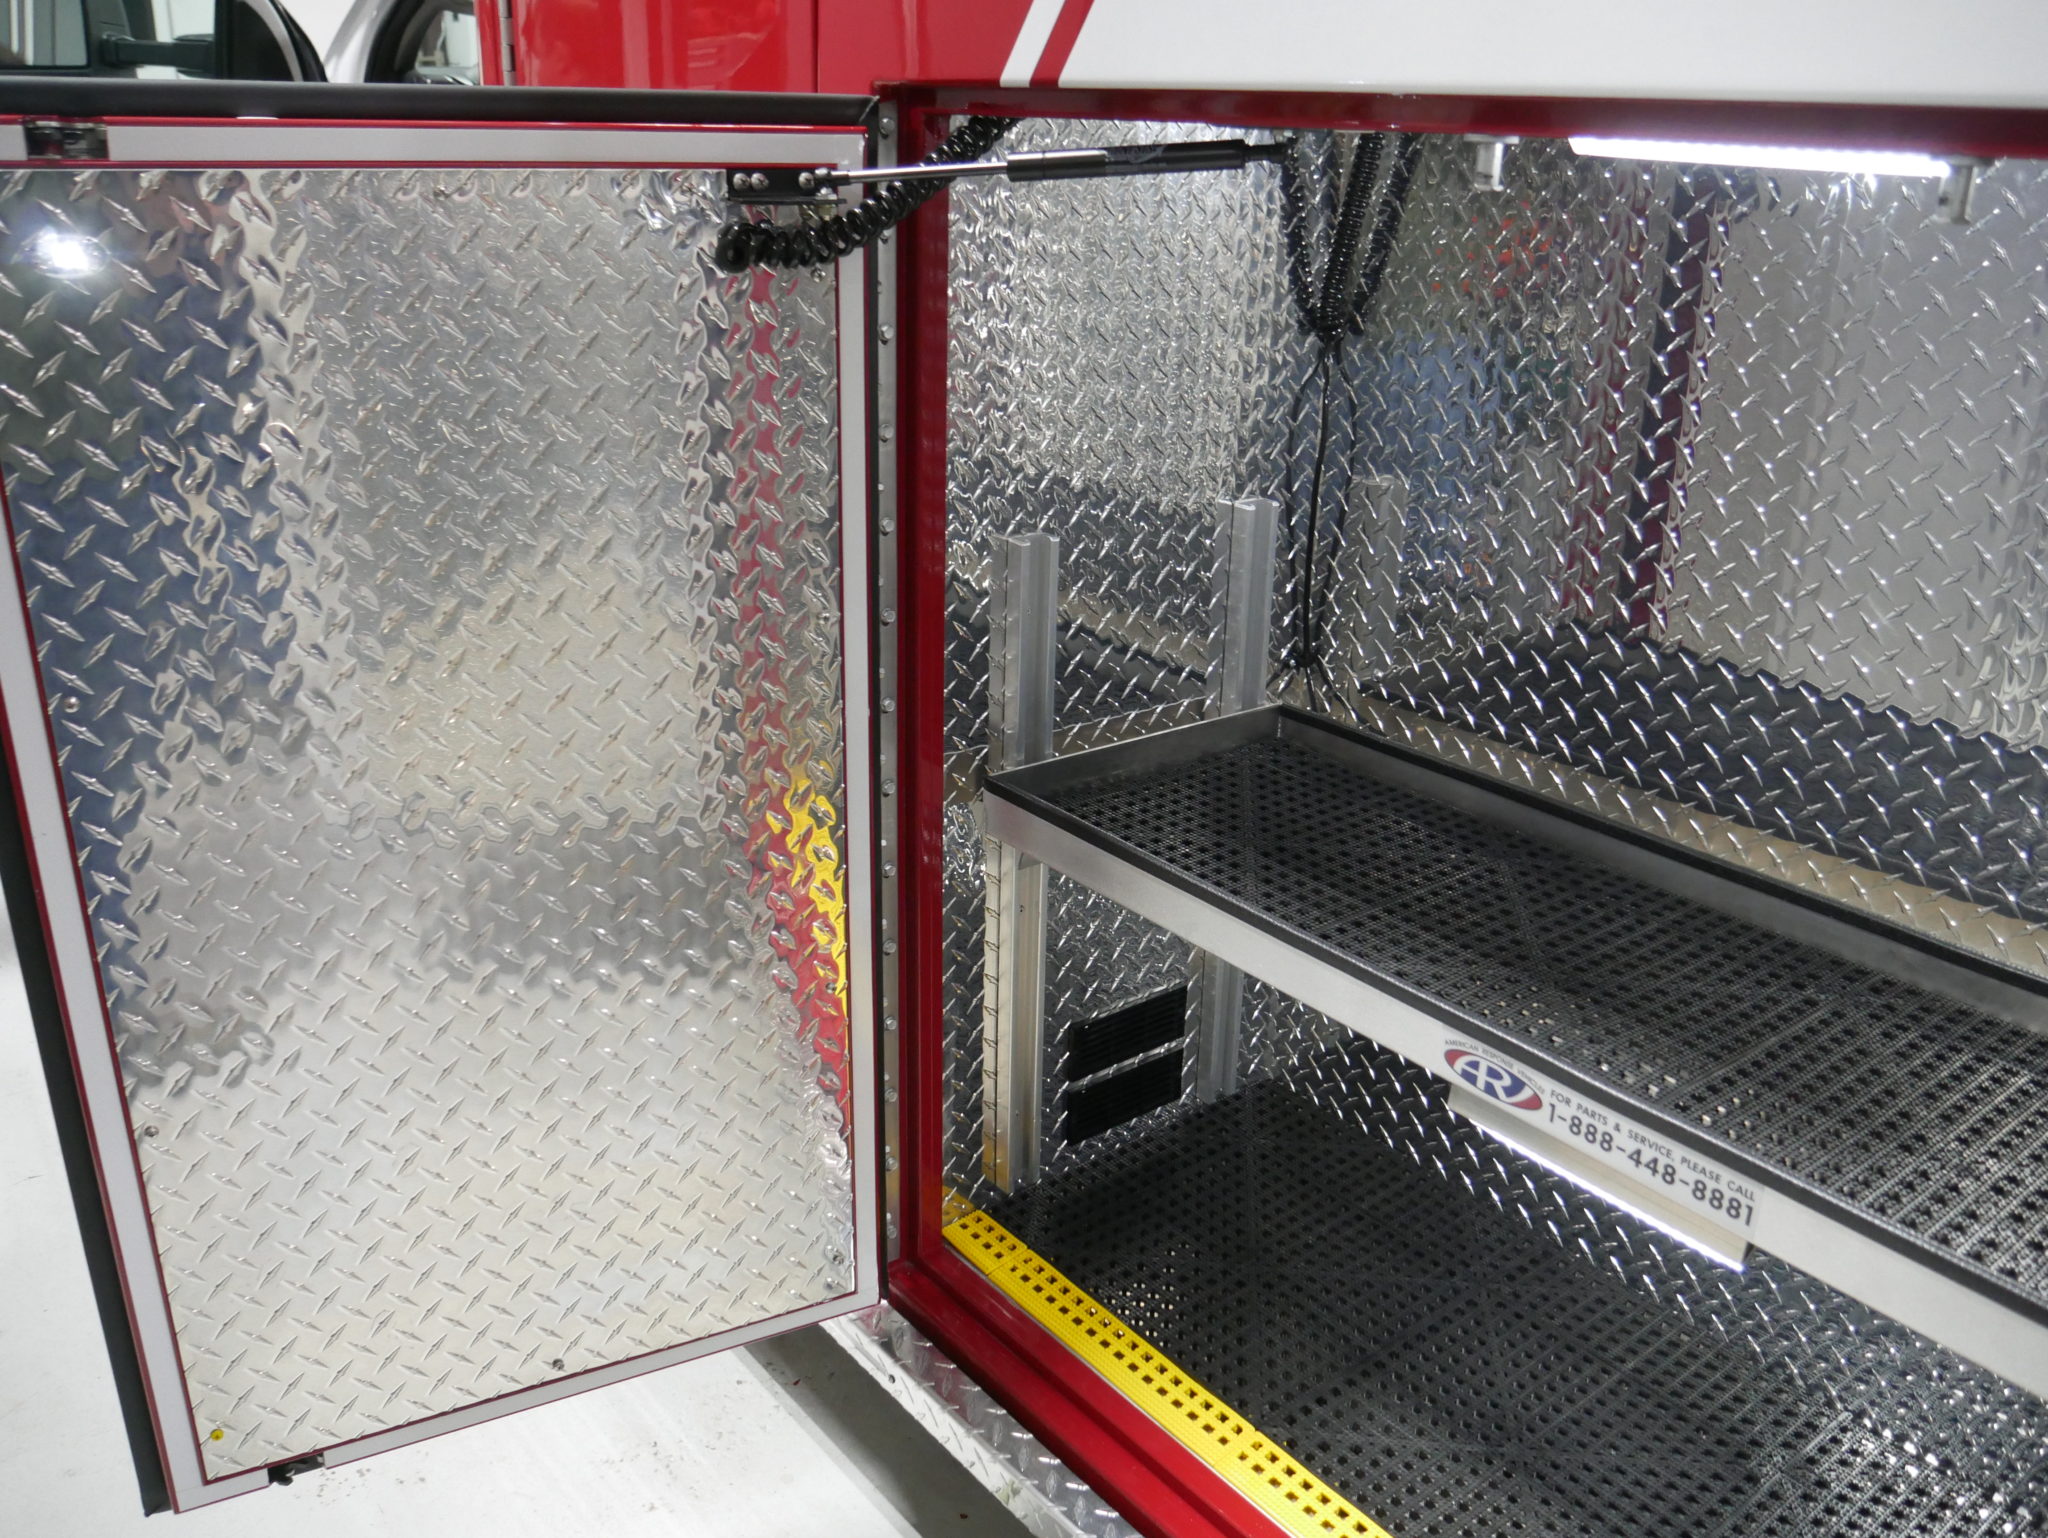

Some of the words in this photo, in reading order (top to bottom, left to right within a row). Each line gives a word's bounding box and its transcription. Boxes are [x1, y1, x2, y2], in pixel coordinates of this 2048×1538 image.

[1445, 1040, 1479, 1052] AMERICAN
[1549, 1102, 1754, 1226] 1-888-448-8881
[1550, 1089, 1571, 1108] FOR
[1576, 1103, 1608, 1126] PARTS
[1613, 1123, 1621, 1133] &
[1680, 1156, 1722, 1184] PLEASE
[1727, 1180, 1755, 1202] CALL
